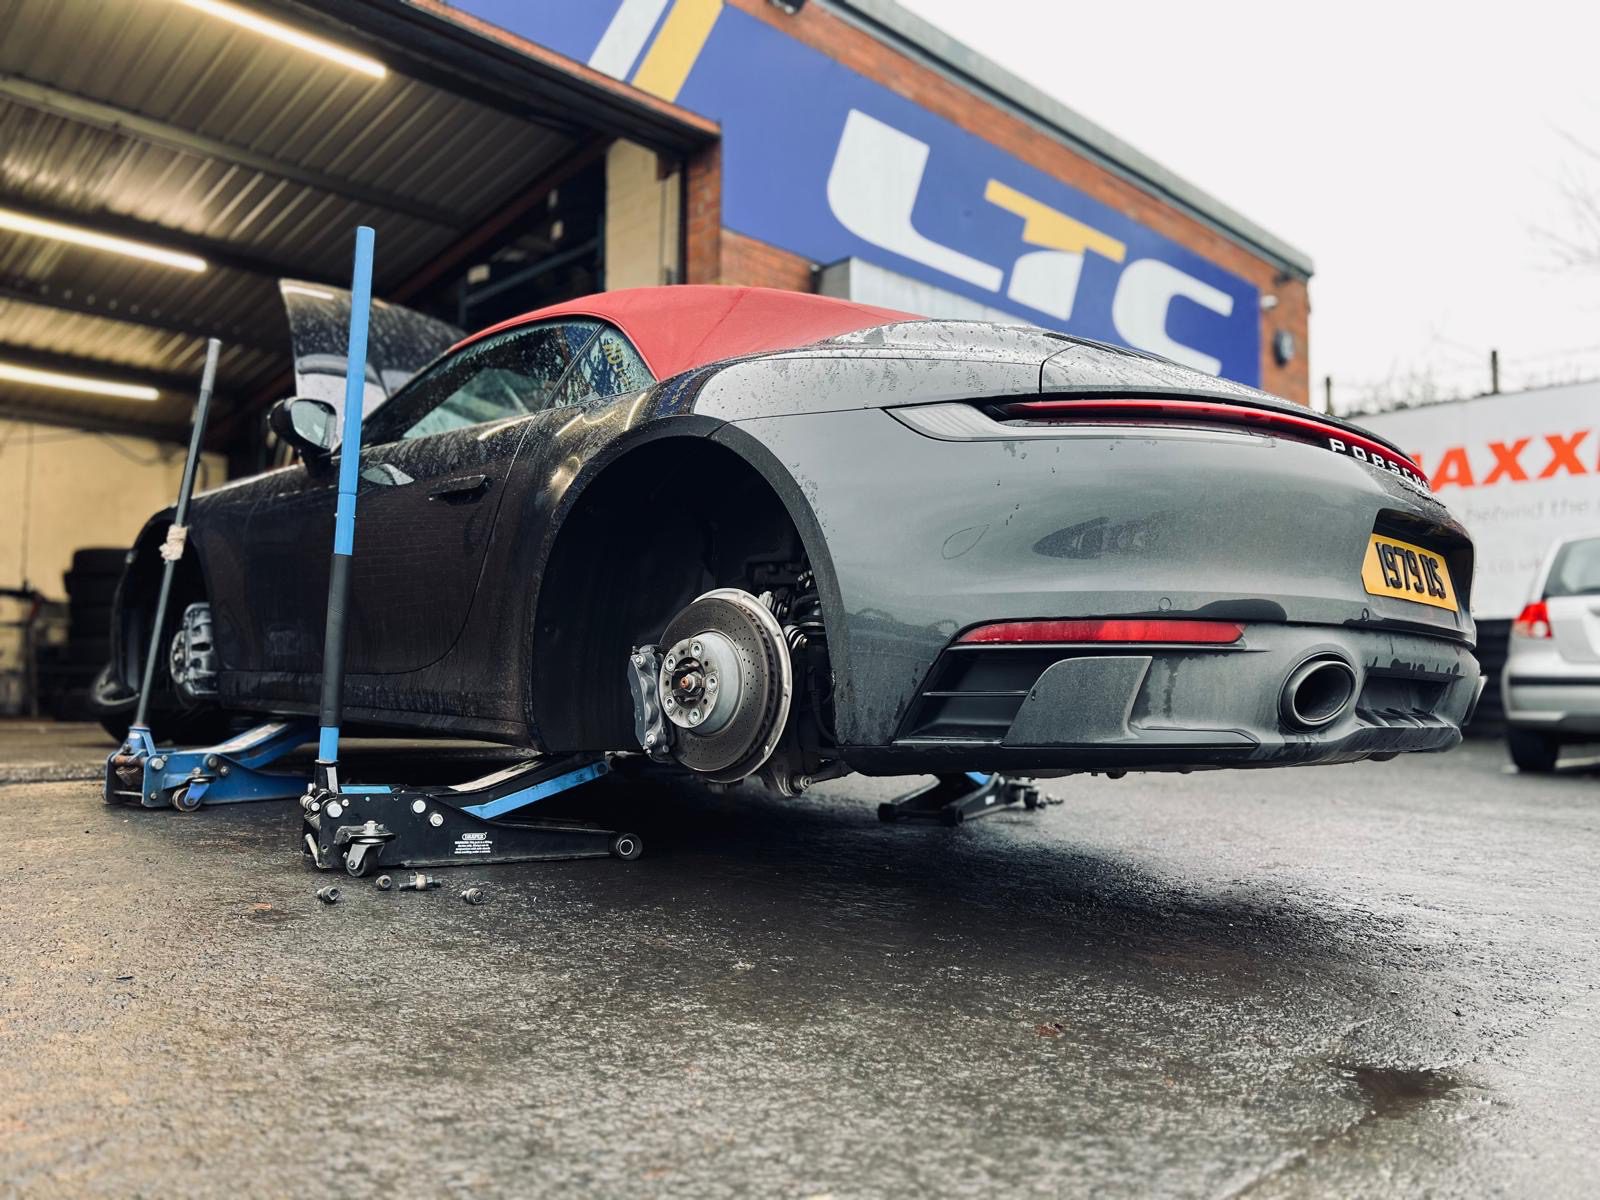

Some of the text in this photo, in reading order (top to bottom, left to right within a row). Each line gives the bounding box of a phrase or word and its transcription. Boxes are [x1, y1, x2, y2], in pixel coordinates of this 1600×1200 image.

[1409, 430, 1600, 493] AXX
[1551, 498, 1589, 516] the
[1375, 542, 1446, 599] 1979 DS
